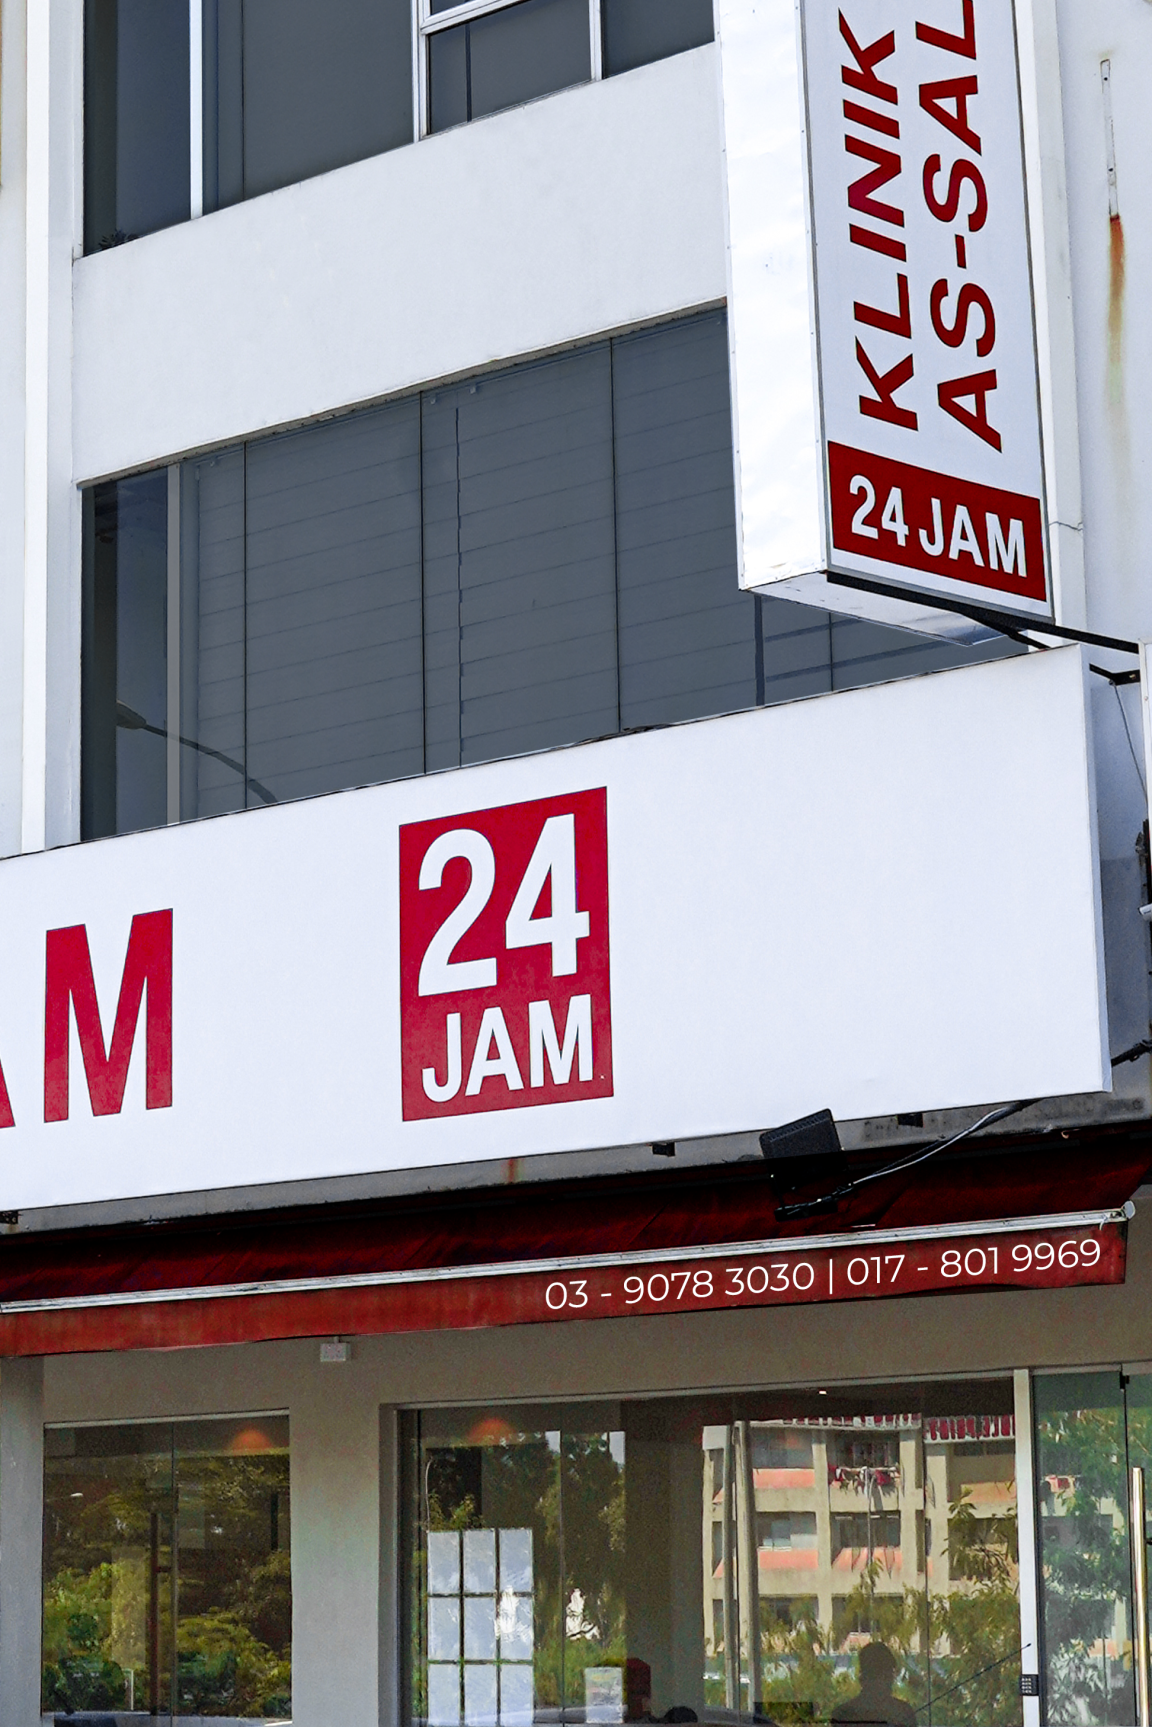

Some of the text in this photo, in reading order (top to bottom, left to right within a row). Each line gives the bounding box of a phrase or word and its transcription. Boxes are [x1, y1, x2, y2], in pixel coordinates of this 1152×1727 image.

[838, 8, 919, 431] KLINIK
[914, 0, 1002, 453] AS-SAL
[849, 474, 1027, 578] 24 JAM
[418, 813, 590, 997] 24
[422, 993, 594, 1103] JAM
[545, 1279, 588, 1310] 03
[623, 1270, 714, 1304] 9078
[724, 1262, 815, 1296] 3030
[846, 1254, 905, 1286] 017
[940, 1246, 999, 1278] 801
[1011, 1238, 1101, 1272] 9969
